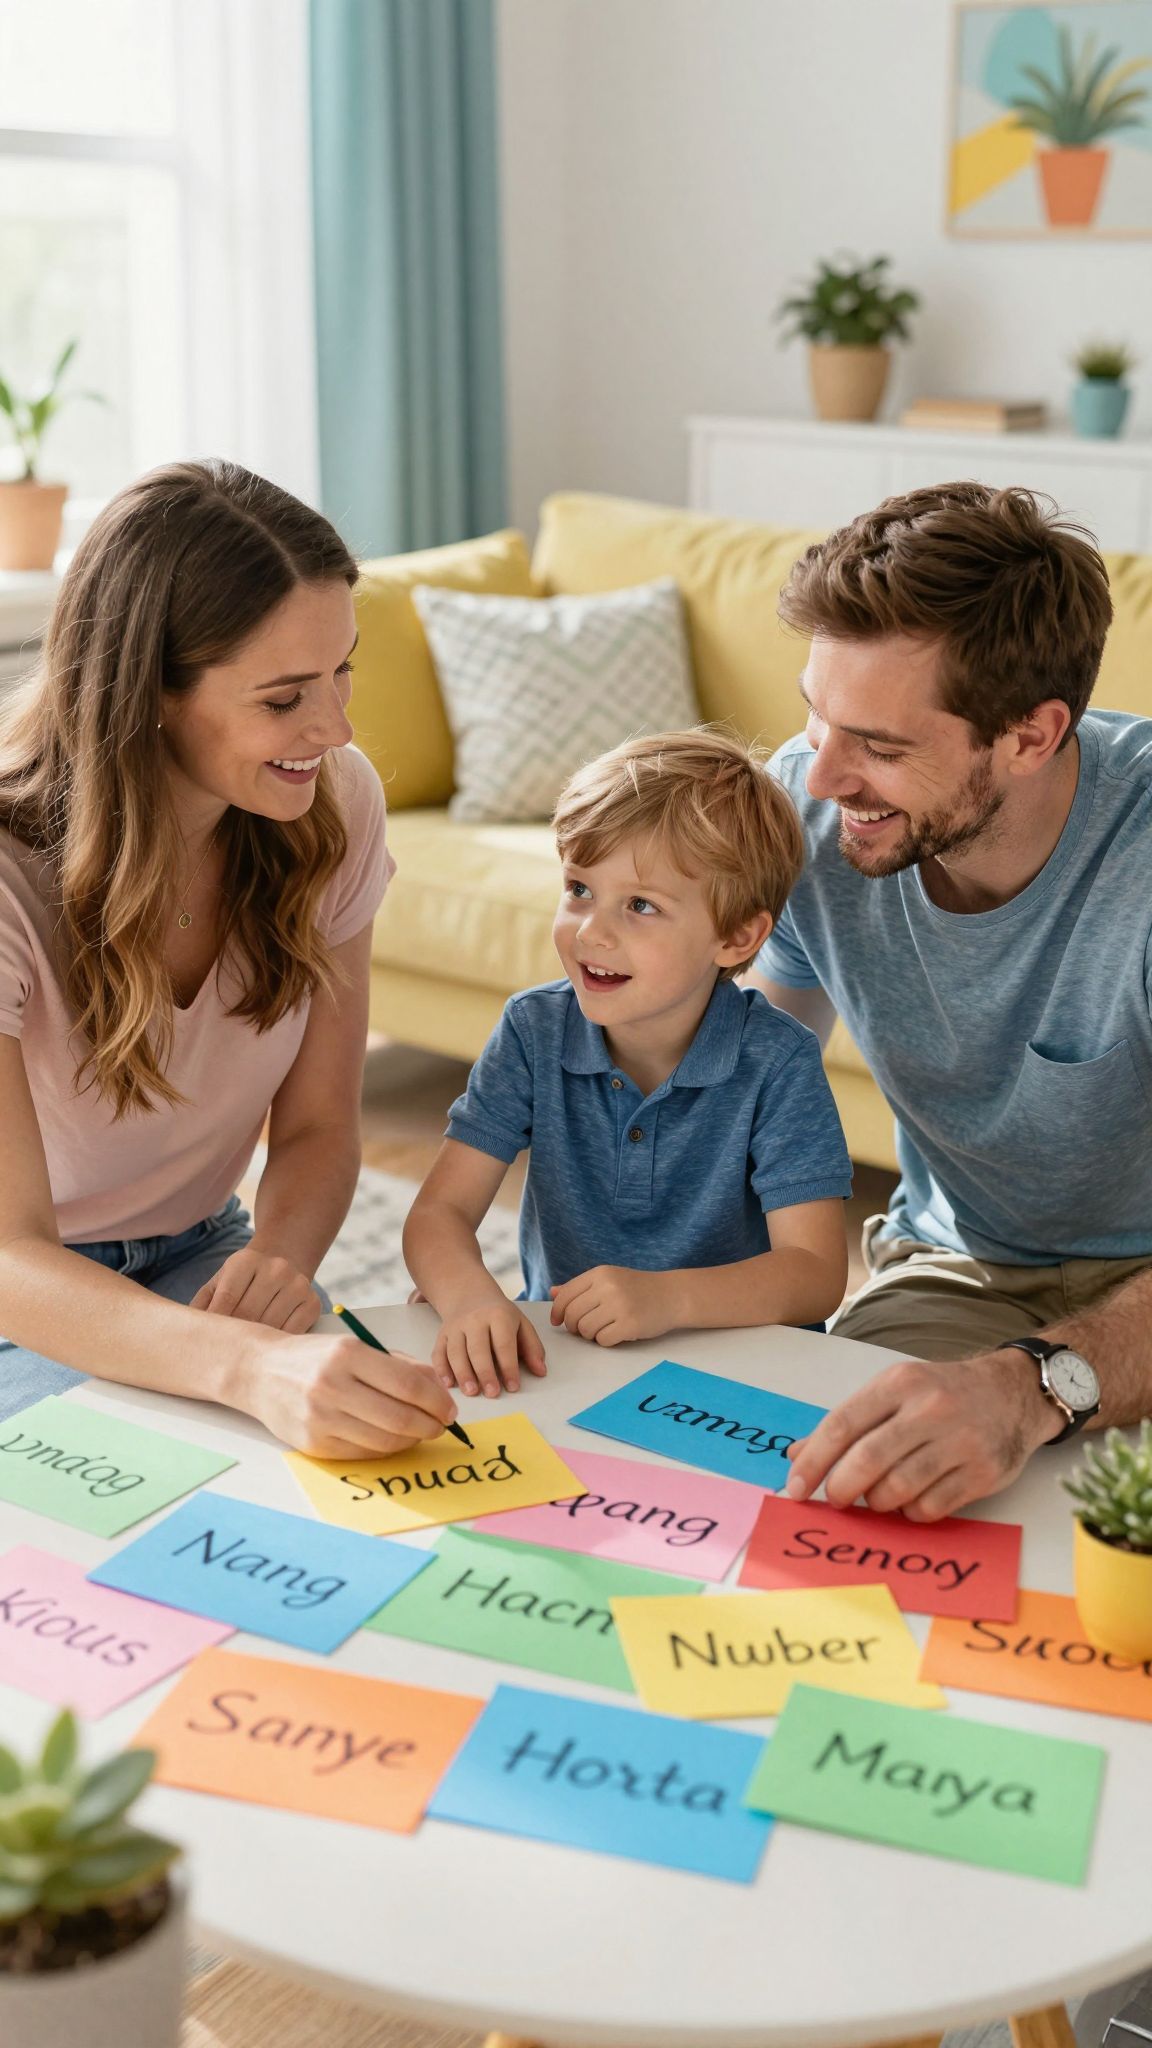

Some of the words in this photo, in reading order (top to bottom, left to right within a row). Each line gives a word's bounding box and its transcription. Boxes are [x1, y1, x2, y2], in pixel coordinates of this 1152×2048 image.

[171, 1529, 347, 1610] Nang
[185, 1688, 416, 1776] Sanye
[502, 1730, 728, 1818] Horta
